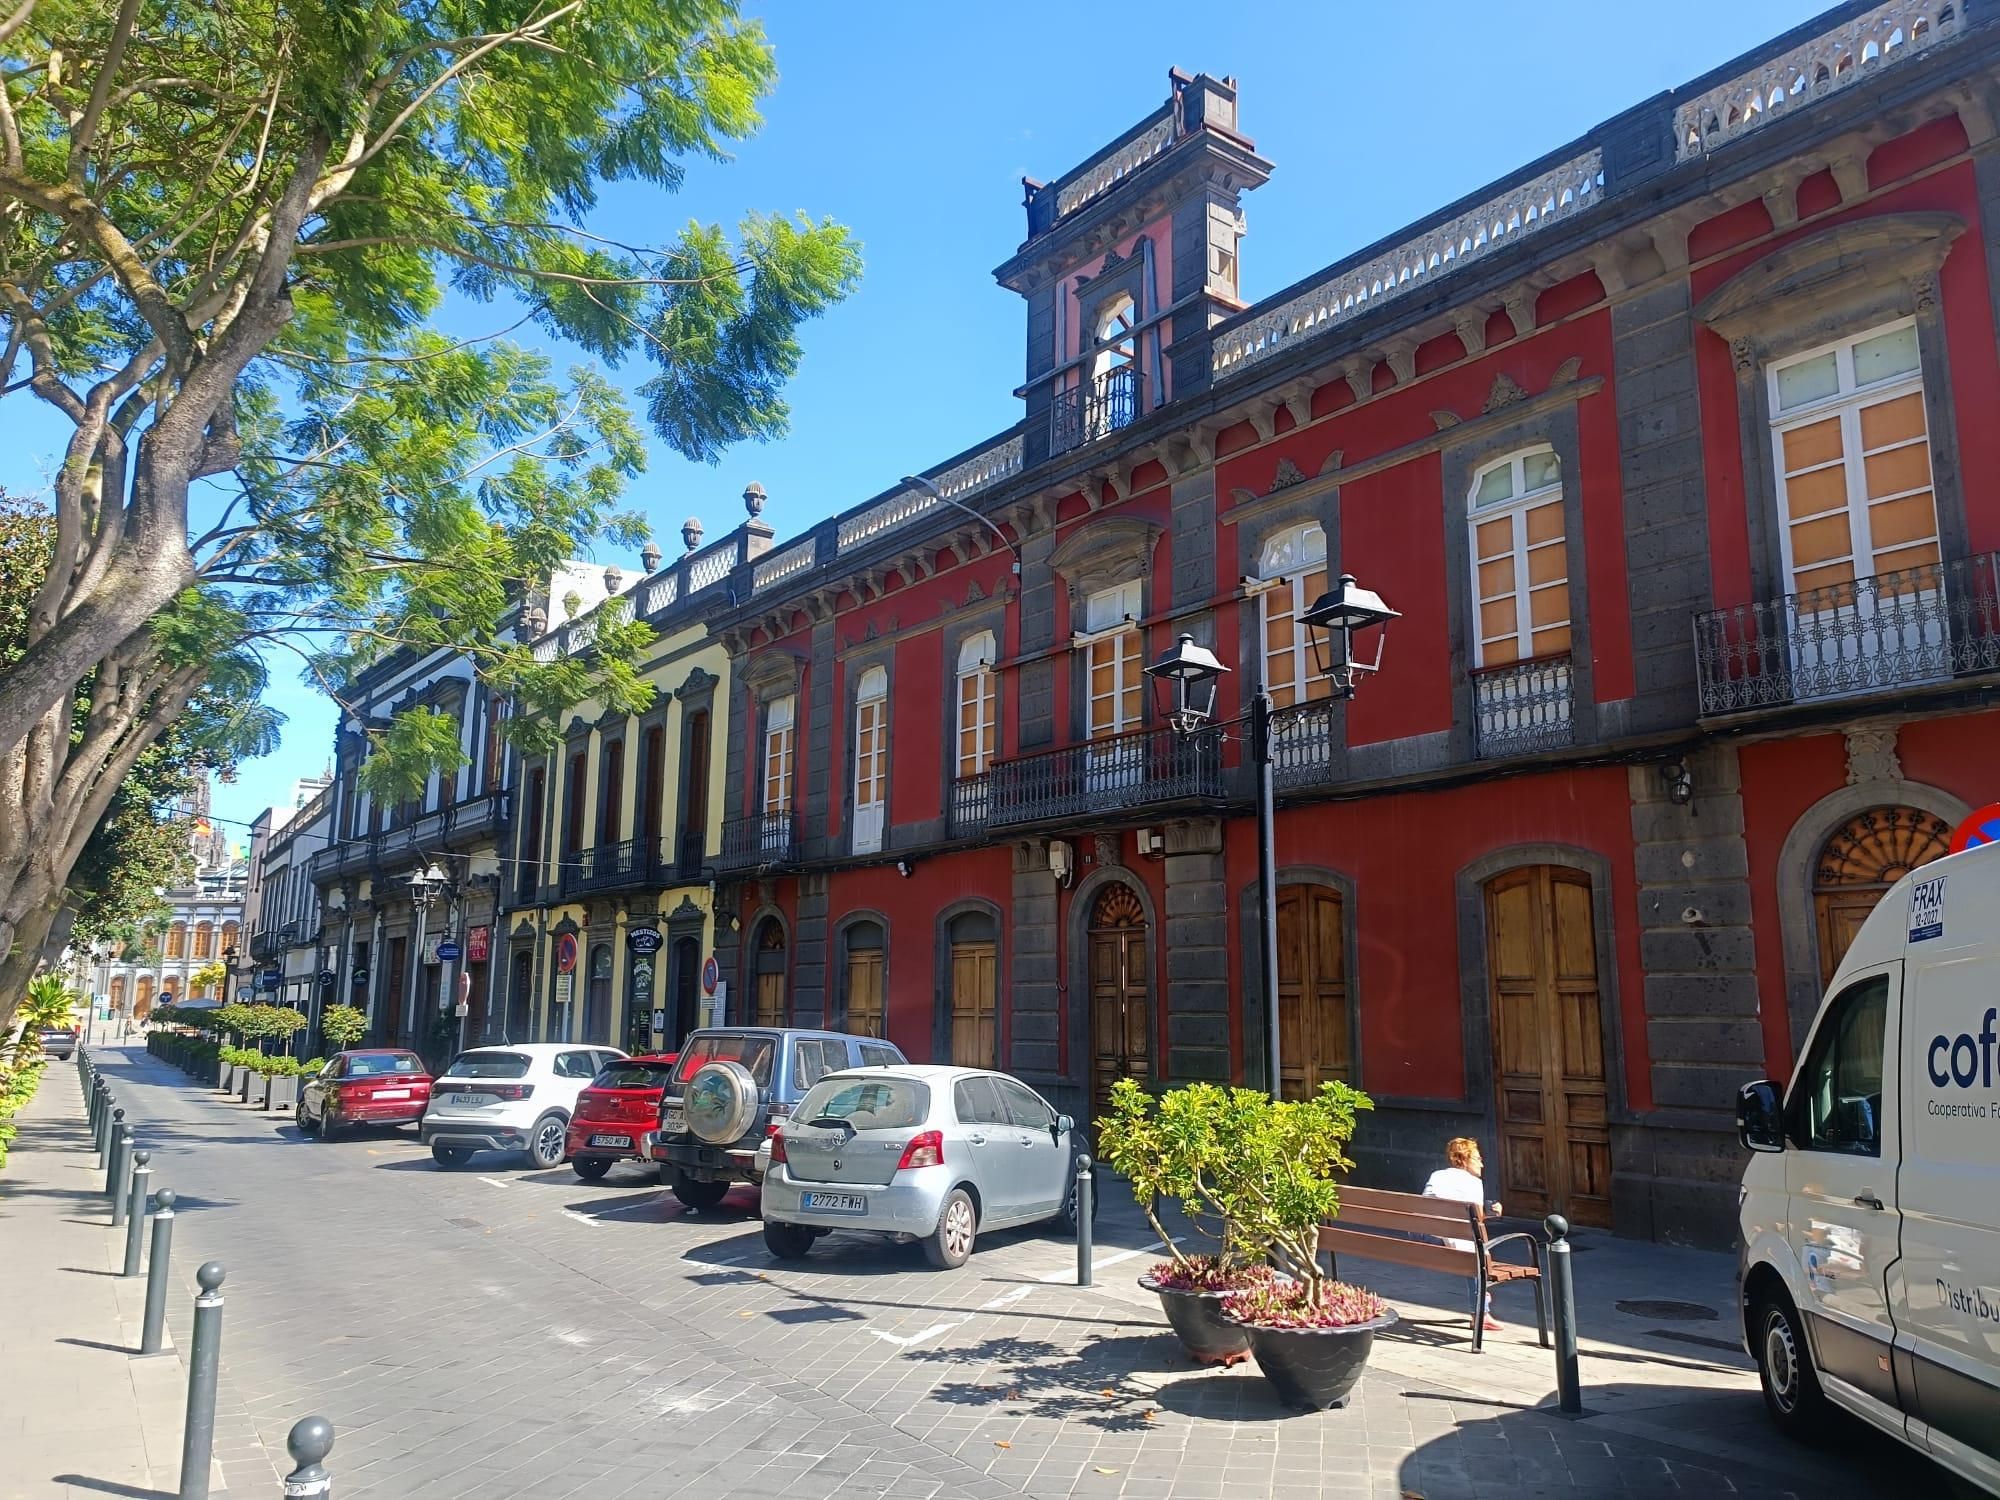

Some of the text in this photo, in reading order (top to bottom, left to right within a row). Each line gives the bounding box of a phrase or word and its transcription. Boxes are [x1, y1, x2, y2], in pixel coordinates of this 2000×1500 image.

[1912, 879, 1945, 912] FRAX
[1915, 909, 1938, 926] 12-2027
[1927, 1007, 2000, 1088] cof
[1928, 1100, 1985, 1119] Cooperativa
[811, 1195, 863, 1210] 2772 FWH
[1936, 1277, 2000, 1323] Distribu
